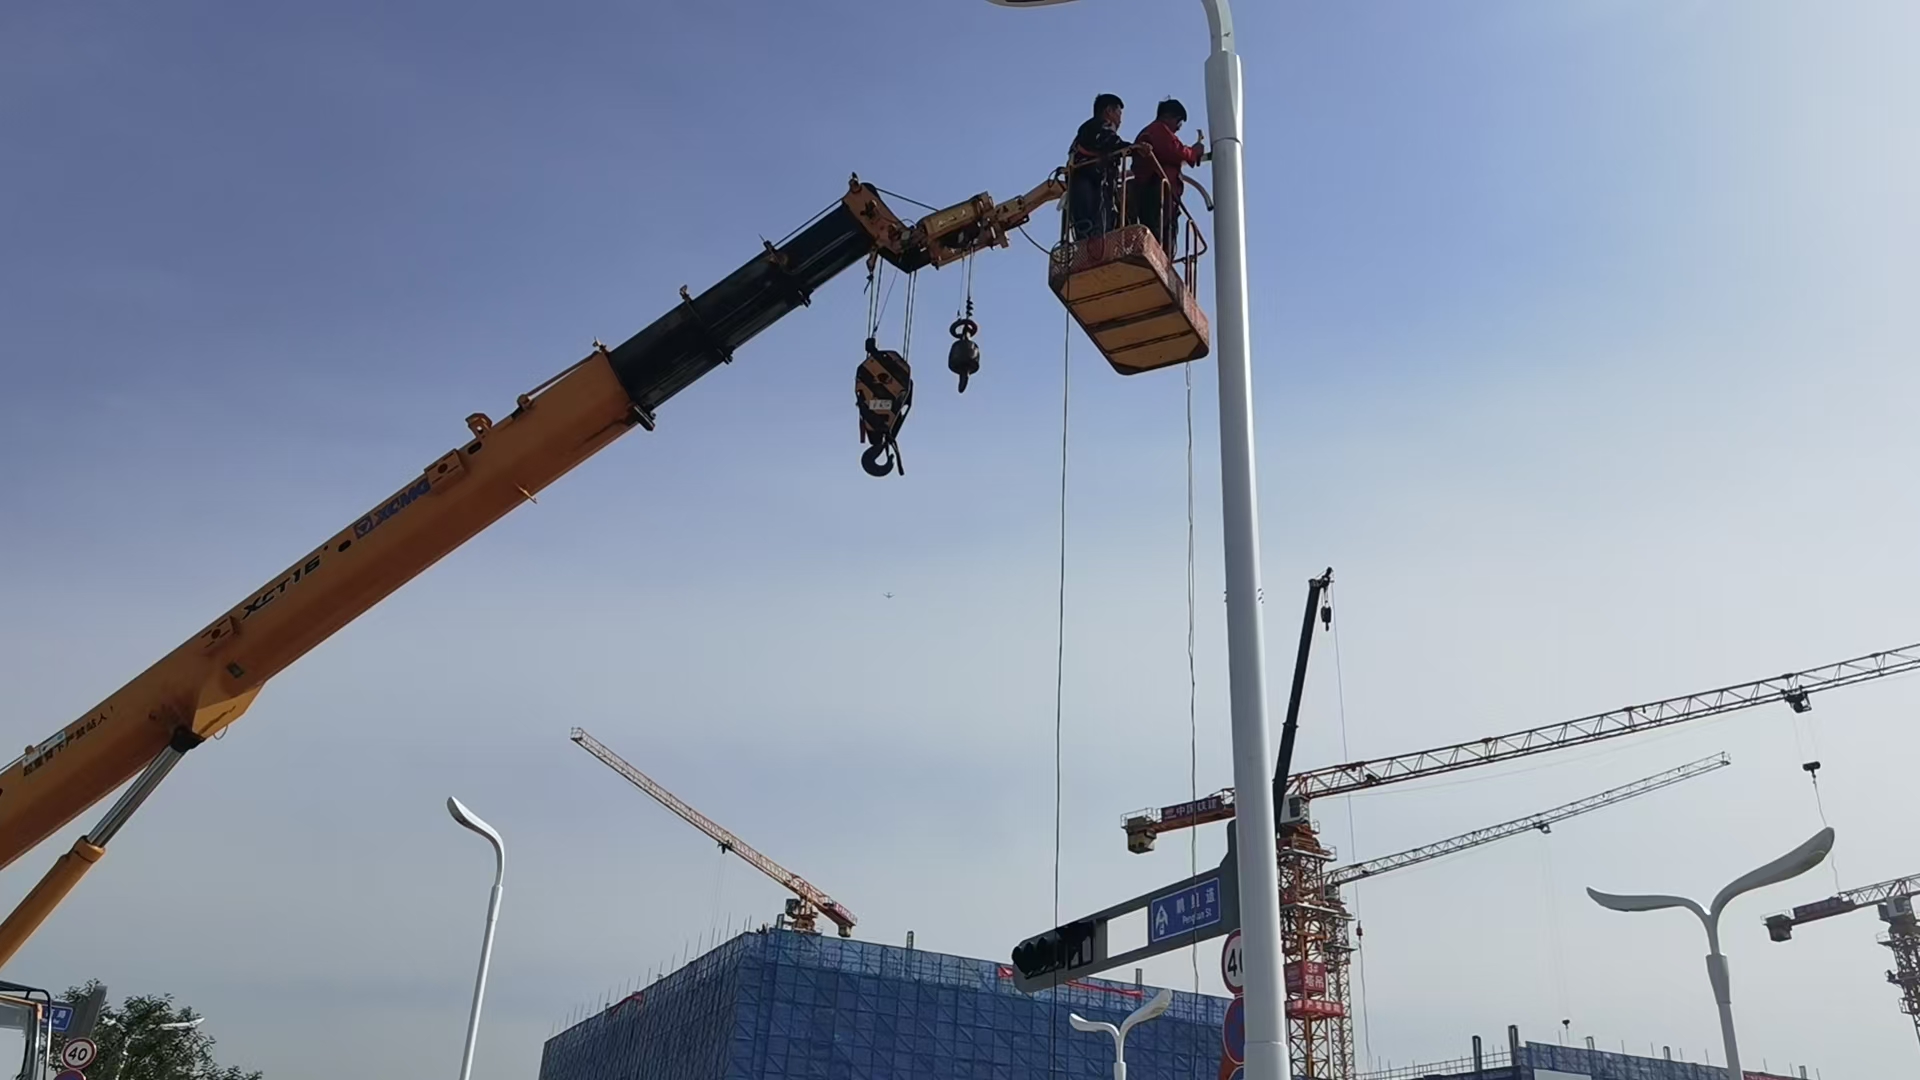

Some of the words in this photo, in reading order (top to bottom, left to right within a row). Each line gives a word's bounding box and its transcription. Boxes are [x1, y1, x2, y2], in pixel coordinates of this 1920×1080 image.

[374, 478, 431, 526] XCMG
[242, 555, 320, 620] XCT16
[1227, 949, 1243, 977] 4
[68, 1047, 88, 1061] 40
